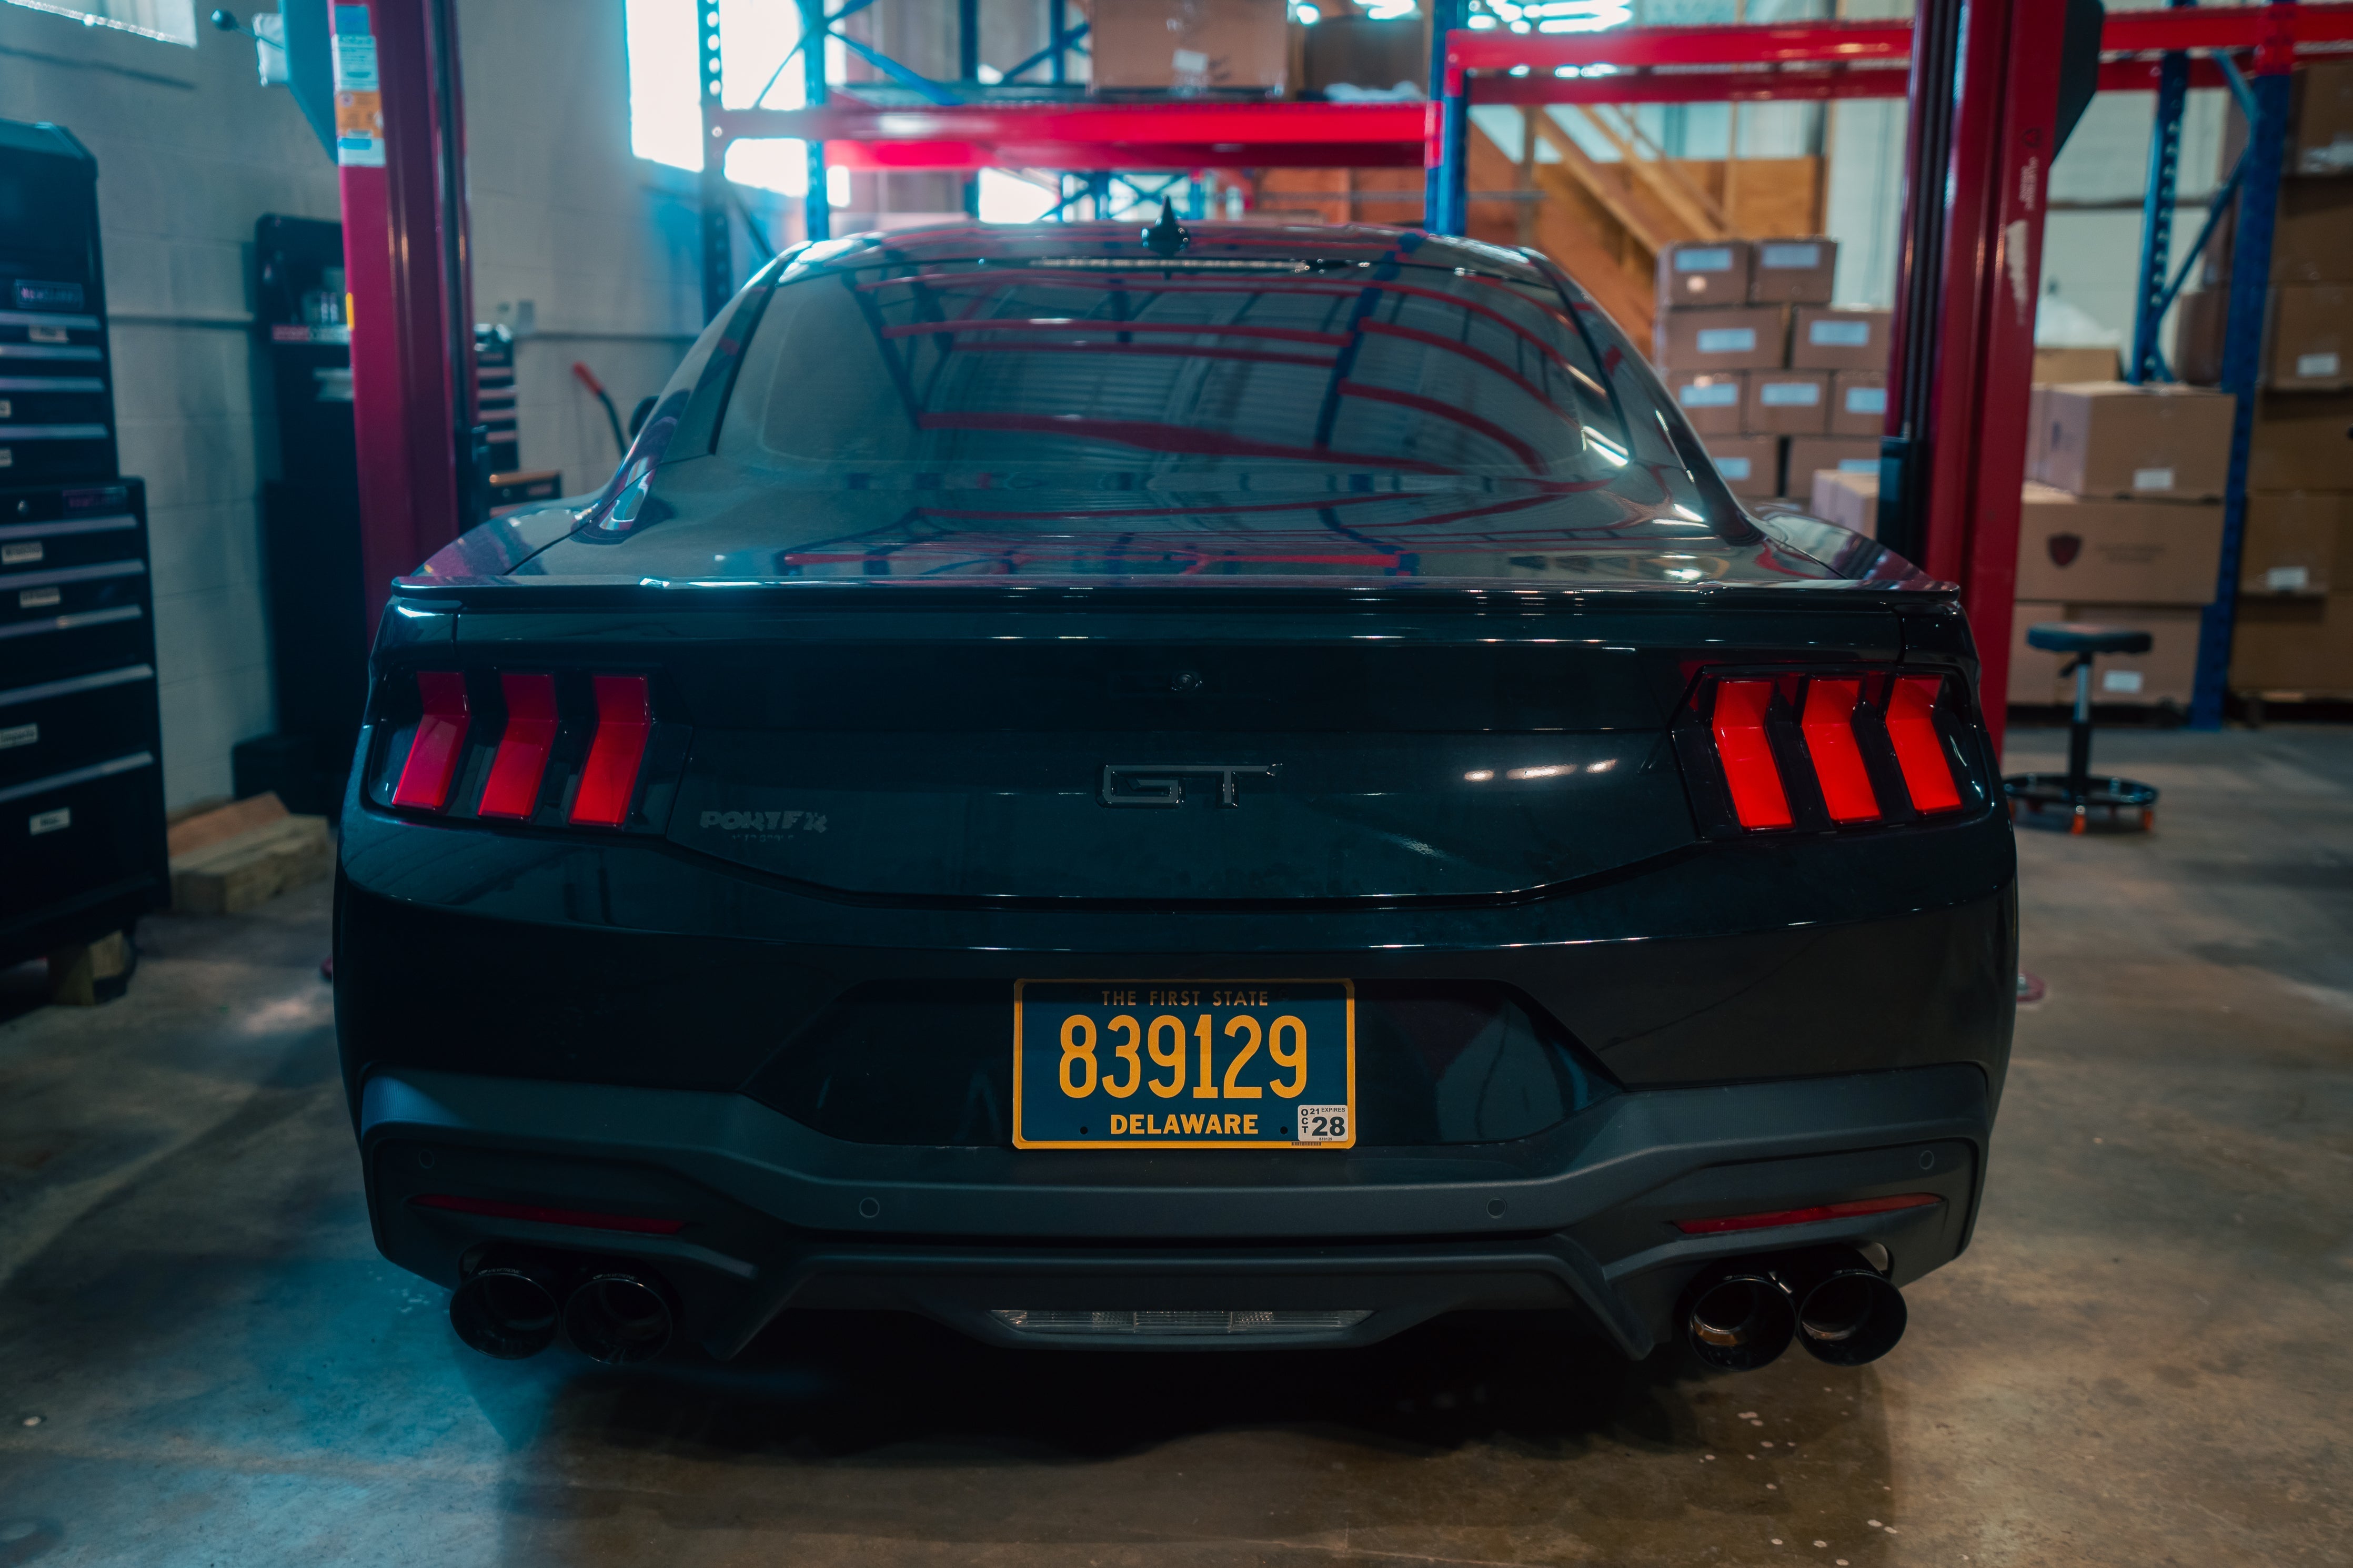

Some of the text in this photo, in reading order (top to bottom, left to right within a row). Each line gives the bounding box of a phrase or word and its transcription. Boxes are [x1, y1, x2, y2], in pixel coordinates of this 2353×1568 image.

[1096, 763, 1283, 808] GT
[1102, 991, 1268, 1006] THE FIRST STATE
[1059, 1014, 1307, 1099] 839129
[1110, 1114, 1259, 1135] DELAWARE
[1312, 1116, 1345, 1136] 28
